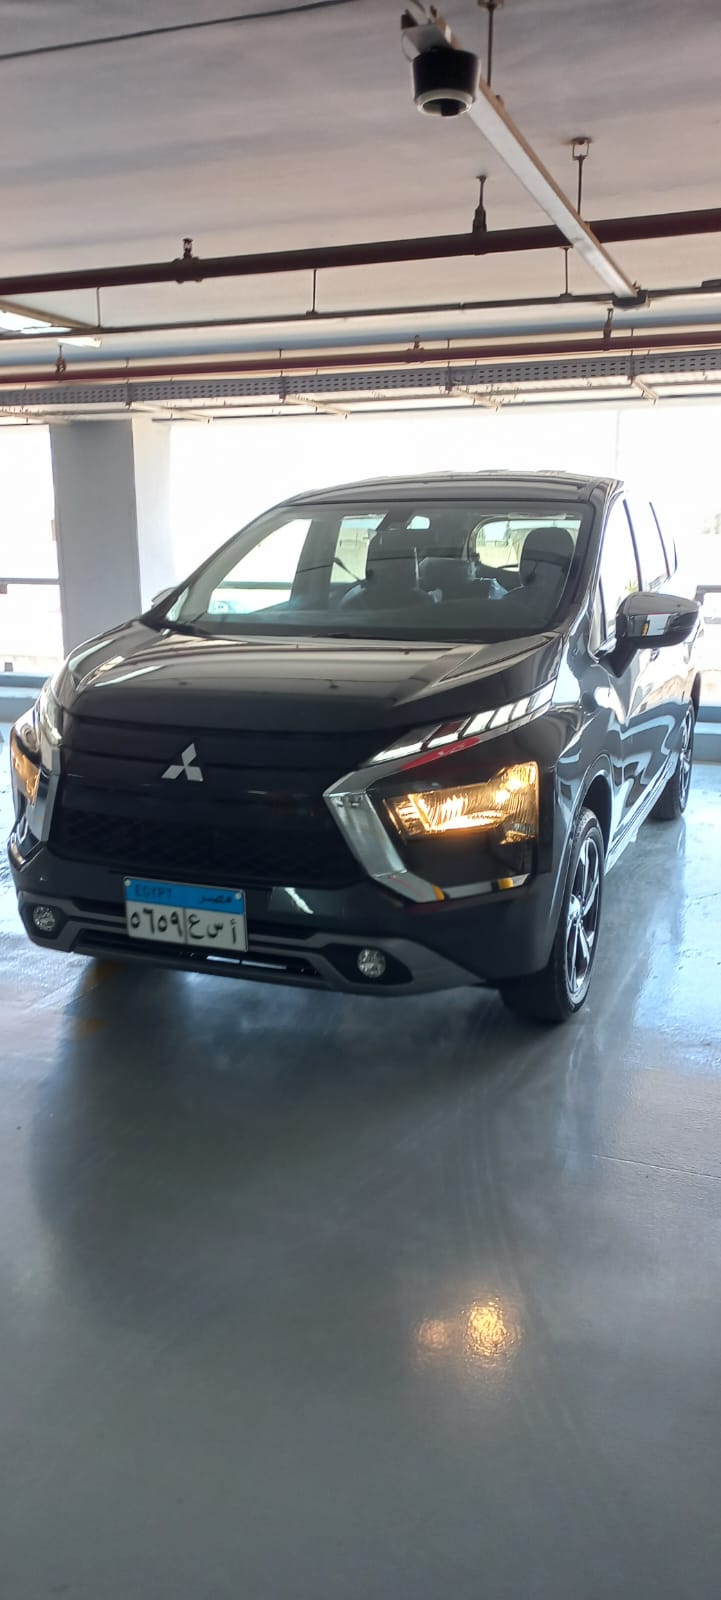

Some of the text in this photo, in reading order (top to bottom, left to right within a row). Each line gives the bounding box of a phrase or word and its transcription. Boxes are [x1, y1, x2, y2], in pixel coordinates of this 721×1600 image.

[135, 884, 172, 899] EGYPT
[200, 894, 232, 904] مصر
[130, 907, 183, 937] ٥٦٥٩
